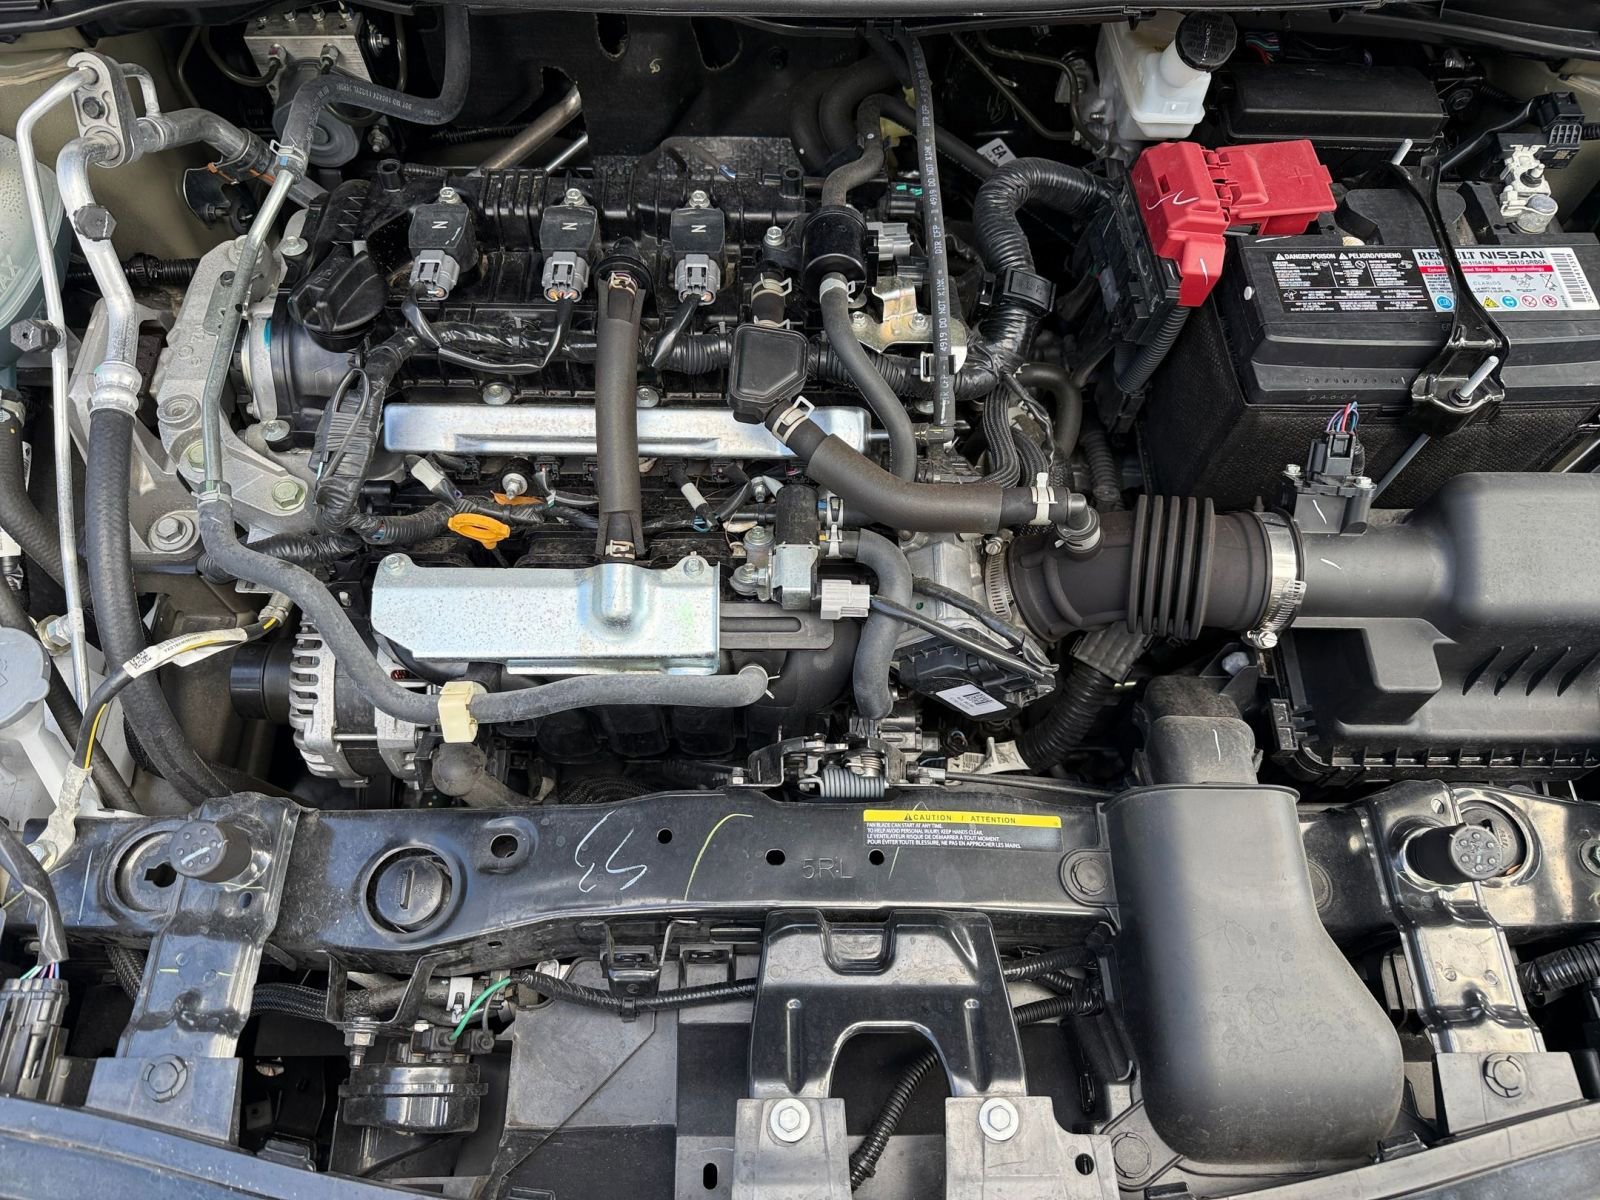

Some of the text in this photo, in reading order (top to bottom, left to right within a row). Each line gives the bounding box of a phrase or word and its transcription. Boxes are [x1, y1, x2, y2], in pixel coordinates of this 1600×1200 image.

[992, 144, 1008, 160] EA
[926, 163, 935, 177] NOT
[928, 178, 937, 188] DO
[929, 190, 938, 206] 4919
[932, 224, 942, 239] CFP
[934, 241, 943, 254] DTR
[1479, 251, 1545, 259] NISSAN
[938, 300, 947, 315] NOT
[939, 318, 948, 328] DO
[940, 330, 948, 351] 4919
[970, 815, 1017, 825] ATTENTION
[802, 857, 854, 879] 5RL
